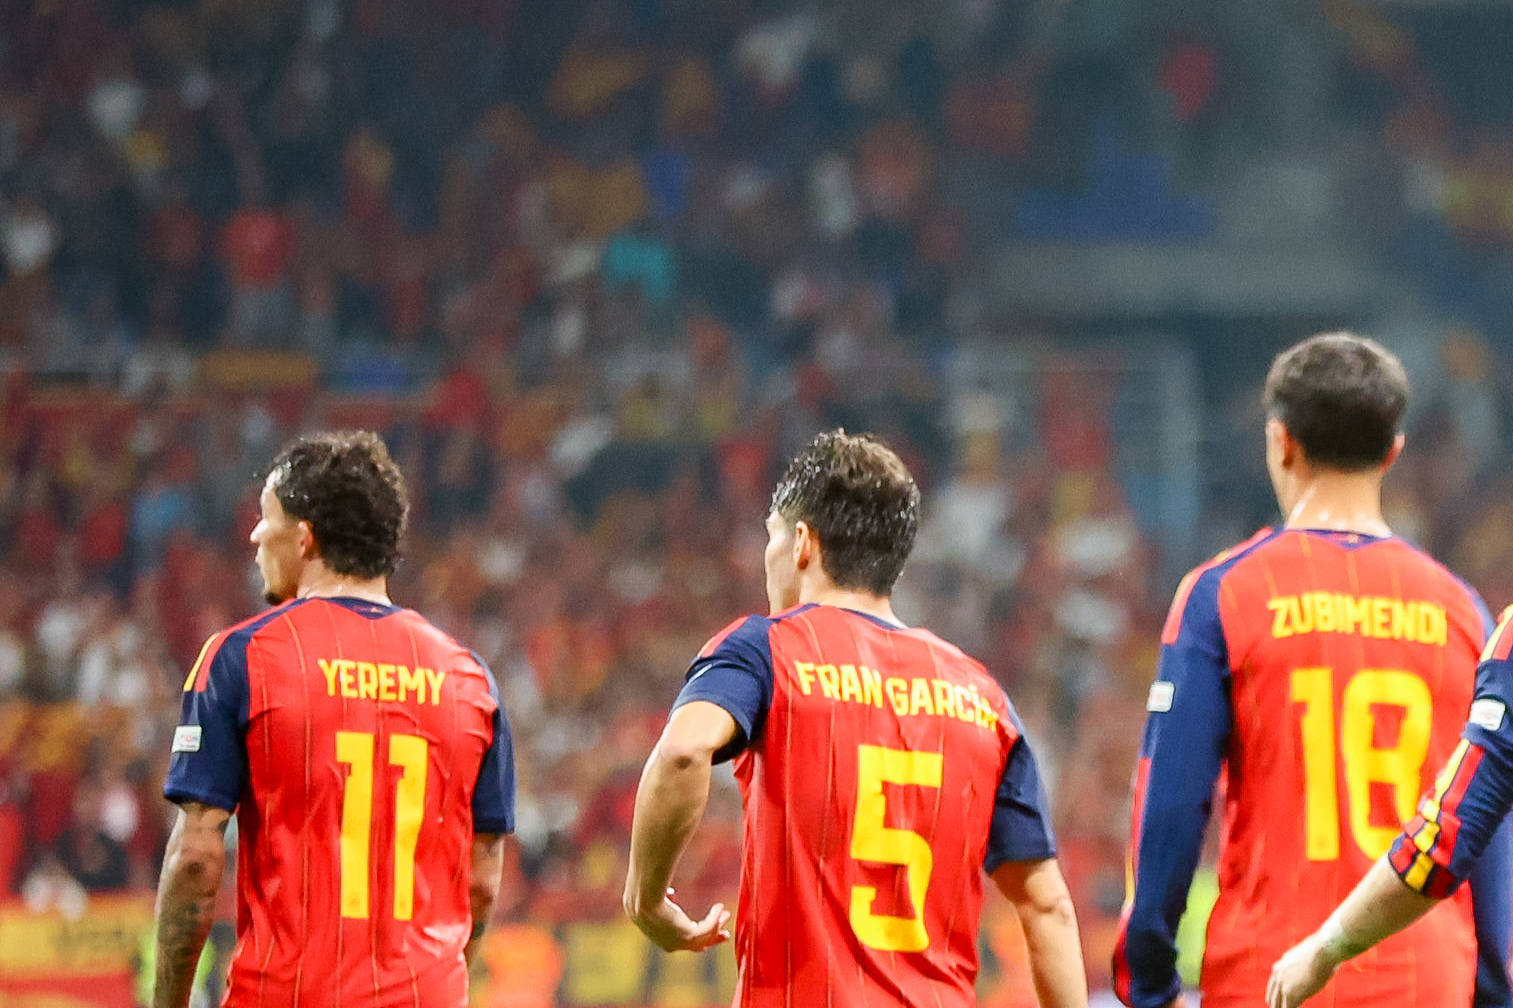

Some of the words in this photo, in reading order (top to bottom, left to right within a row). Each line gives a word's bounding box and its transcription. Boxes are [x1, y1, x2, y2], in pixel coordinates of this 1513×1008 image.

[1267, 590, 1448, 646] ZUBIMENDI
[317, 658, 446, 706] YEREMY
[794, 660, 884, 709] FRAN
[1290, 667, 1433, 861] 18
[335, 731, 429, 920] 11
[849, 743, 943, 953] 5
